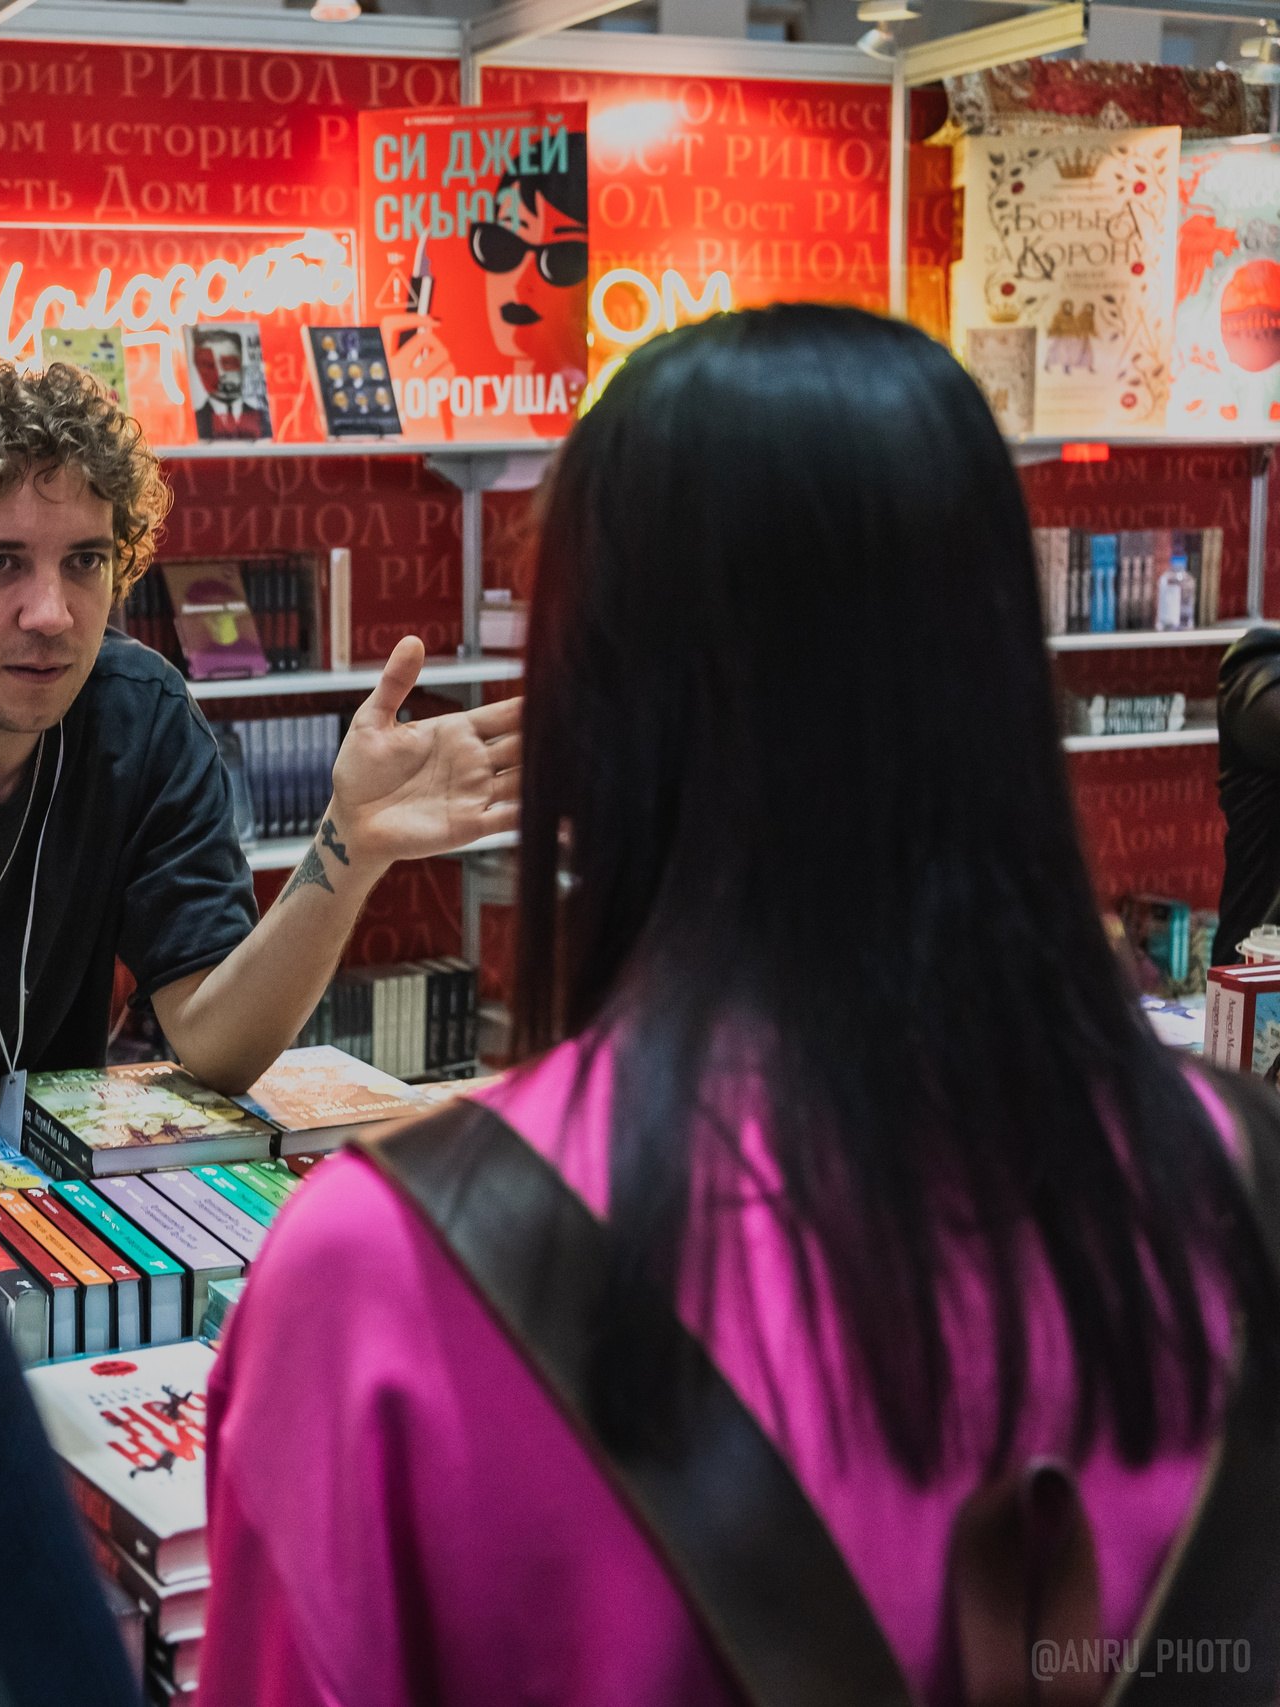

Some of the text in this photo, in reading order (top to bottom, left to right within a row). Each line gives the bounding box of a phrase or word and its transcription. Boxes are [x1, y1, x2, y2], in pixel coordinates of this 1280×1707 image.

[122, 50, 344, 105] РИПОЛ
[72, 114, 294, 170] историй
[373, 113, 570, 188] СИ ДЖЕЙ
[94, 165, 209, 222] Дом
[692, 186, 794, 232] Рост
[696, 239, 876, 285] РИПОЛ
[392, 371, 578, 428] ОРОГУША:
[181, 502, 395, 552] РИПОЛ
